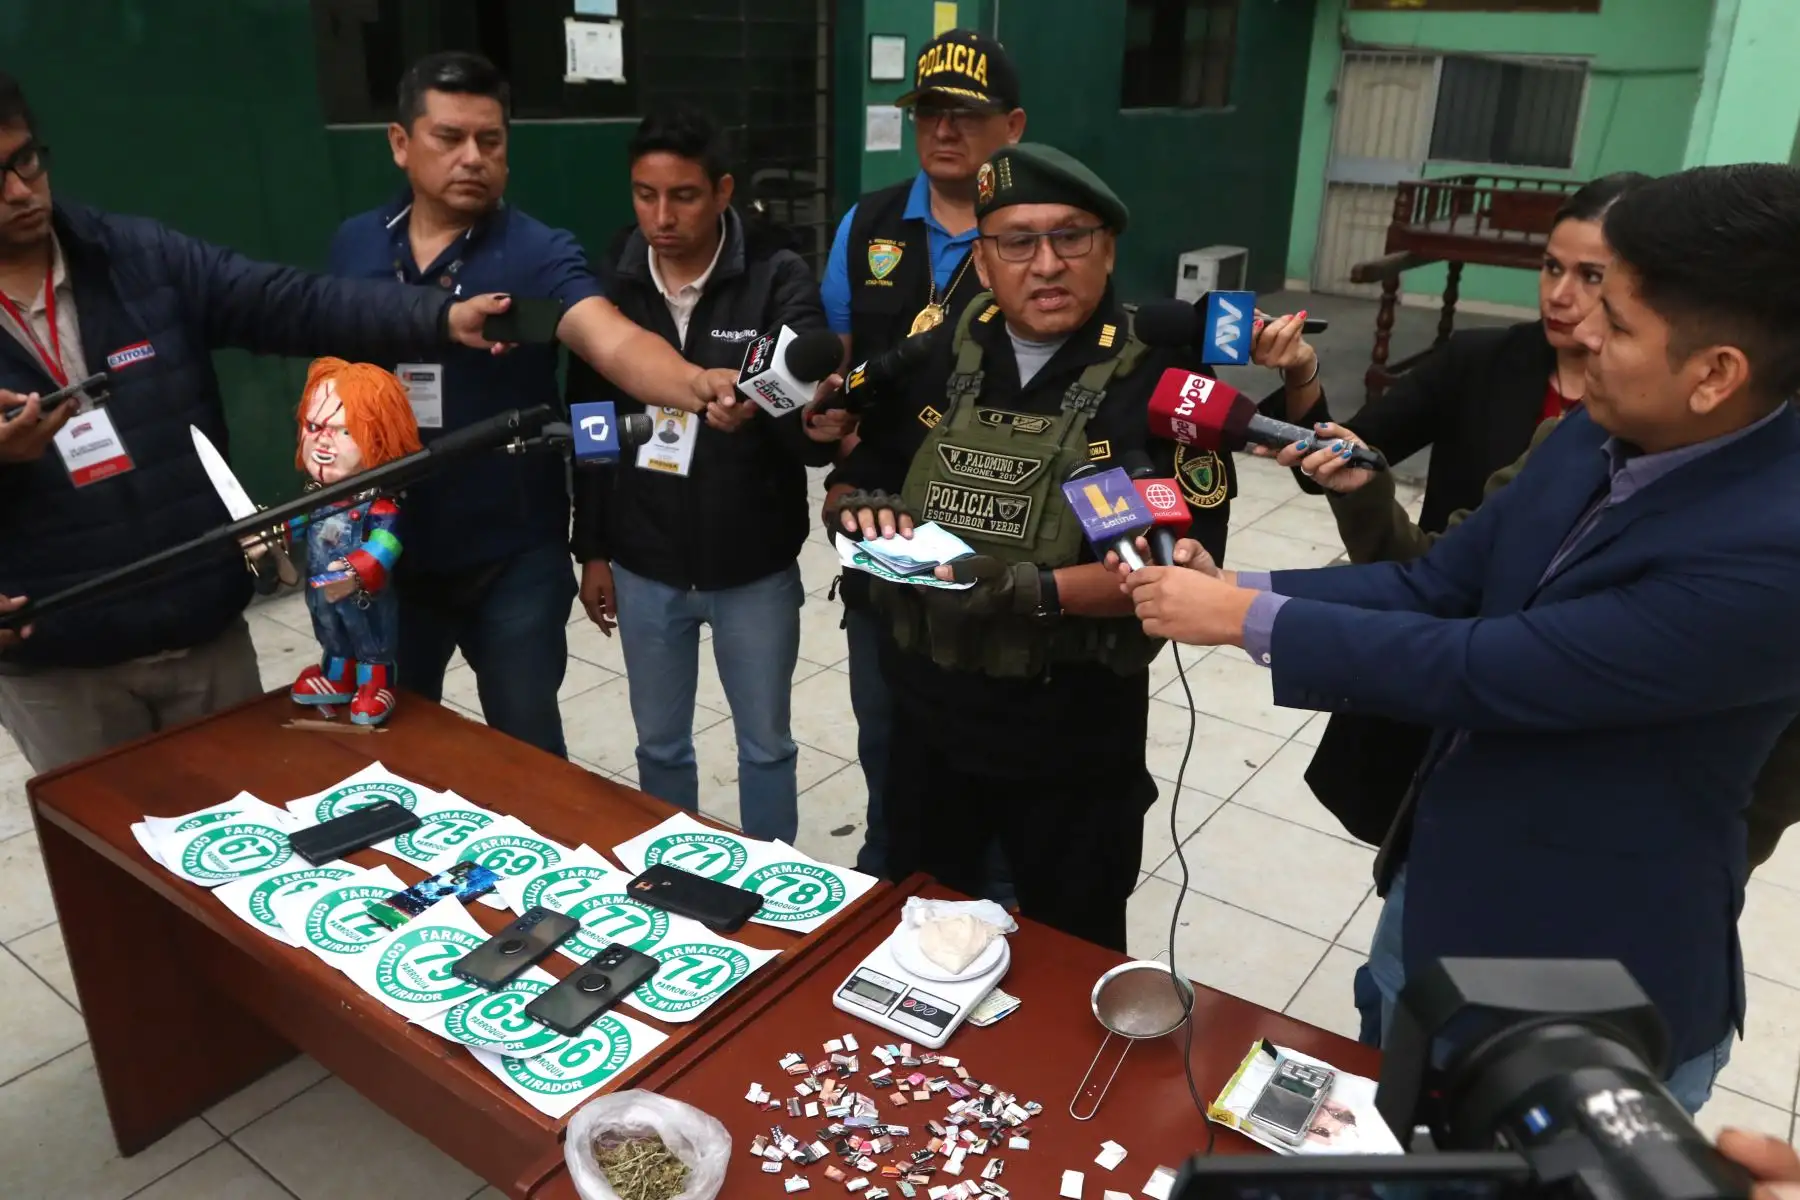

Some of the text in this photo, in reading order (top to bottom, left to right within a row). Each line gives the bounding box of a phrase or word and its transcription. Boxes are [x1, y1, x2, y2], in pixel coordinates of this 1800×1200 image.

[918, 42, 988, 88] POLICIA
[109, 346, 155, 366] EXITOSA
[950, 450, 1024, 475] W. PALOMINO S.
[954, 464, 1018, 481] CORONEL 2017
[928, 486, 995, 518] POLICIA
[926, 509, 1020, 534] ESCUADRON VERDE
[1102, 514, 1137, 528] Latina
[338, 784, 404, 796] FARMACIA
[422, 812, 481, 824] ARMACIA
[224, 826, 288, 846] FARMACIA
[423, 821, 478, 845] 75
[472, 838, 543, 852] FARMACIA
[185, 836, 211, 866] COTITO
[218, 836, 274, 864] 67
[482, 849, 537, 876] 69
[666, 836, 744, 870] FARMACIA UNIDA
[672, 844, 726, 871] 71
[338, 888, 392, 900] FARMA
[754, 864, 844, 902] FARMACIA UNIDA
[765, 876, 821, 904] 78
[252, 891, 271, 920] COTITO
[762, 910, 822, 920] MIRADOR
[764, 899, 800, 911] ARROQUIA
[309, 903, 368, 952] COTITO MIRADO
[586, 906, 648, 937] 77
[647, 912, 667, 940] UNIDA
[419, 930, 483, 950] FARMAC
[380, 942, 444, 1001] COTITO MIRADOR
[663, 956, 725, 990] 74
[655, 992, 718, 1010] MIRADOR
[656, 982, 698, 998] PARROQUIA
[448, 1003, 525, 1050] COTITO MIROR
[558, 1038, 604, 1068] 6
[602, 1035, 629, 1070] UNIDA
[515, 1072, 584, 1092] MIRADOR
